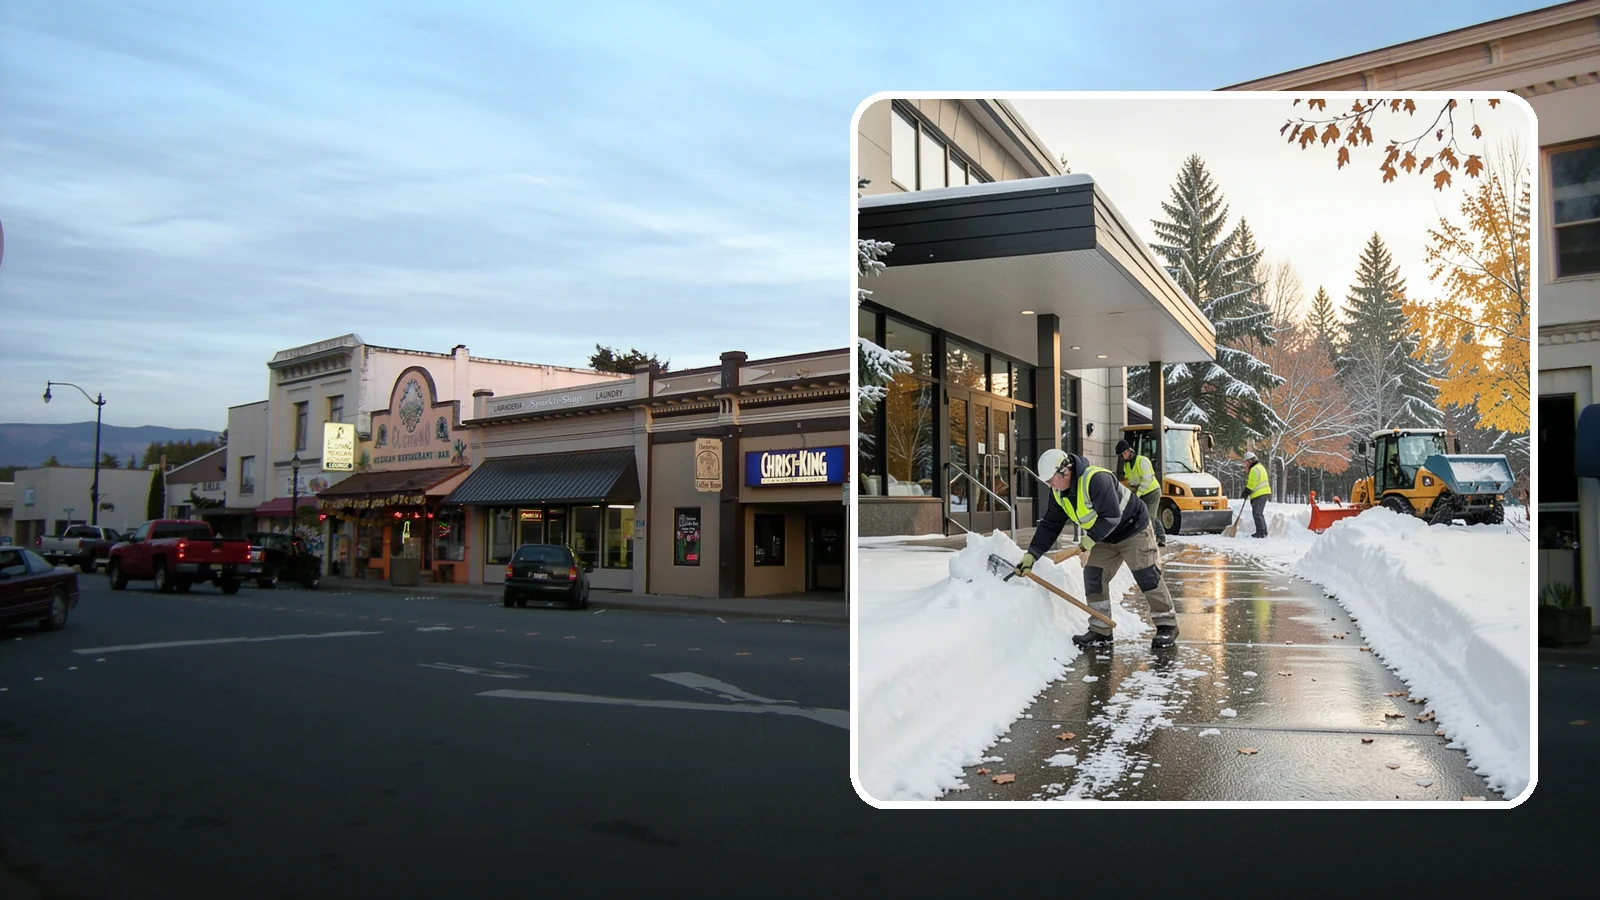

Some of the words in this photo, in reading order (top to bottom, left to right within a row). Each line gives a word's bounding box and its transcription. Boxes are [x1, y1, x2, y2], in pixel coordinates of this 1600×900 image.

[531, 398, 561, 409] Sparkle
[562, 394, 582, 405] Shop
[595, 389, 623, 400] LAUNDRY
[493, 402, 522, 413] LAVANDERIA
[373, 456, 396, 464] MEXICAN
[397, 452, 433, 462] RESTAURANT
[438, 450, 450, 459] BAR
[761, 452, 797, 478] CHRIST
[799, 450, 827, 476] KING
